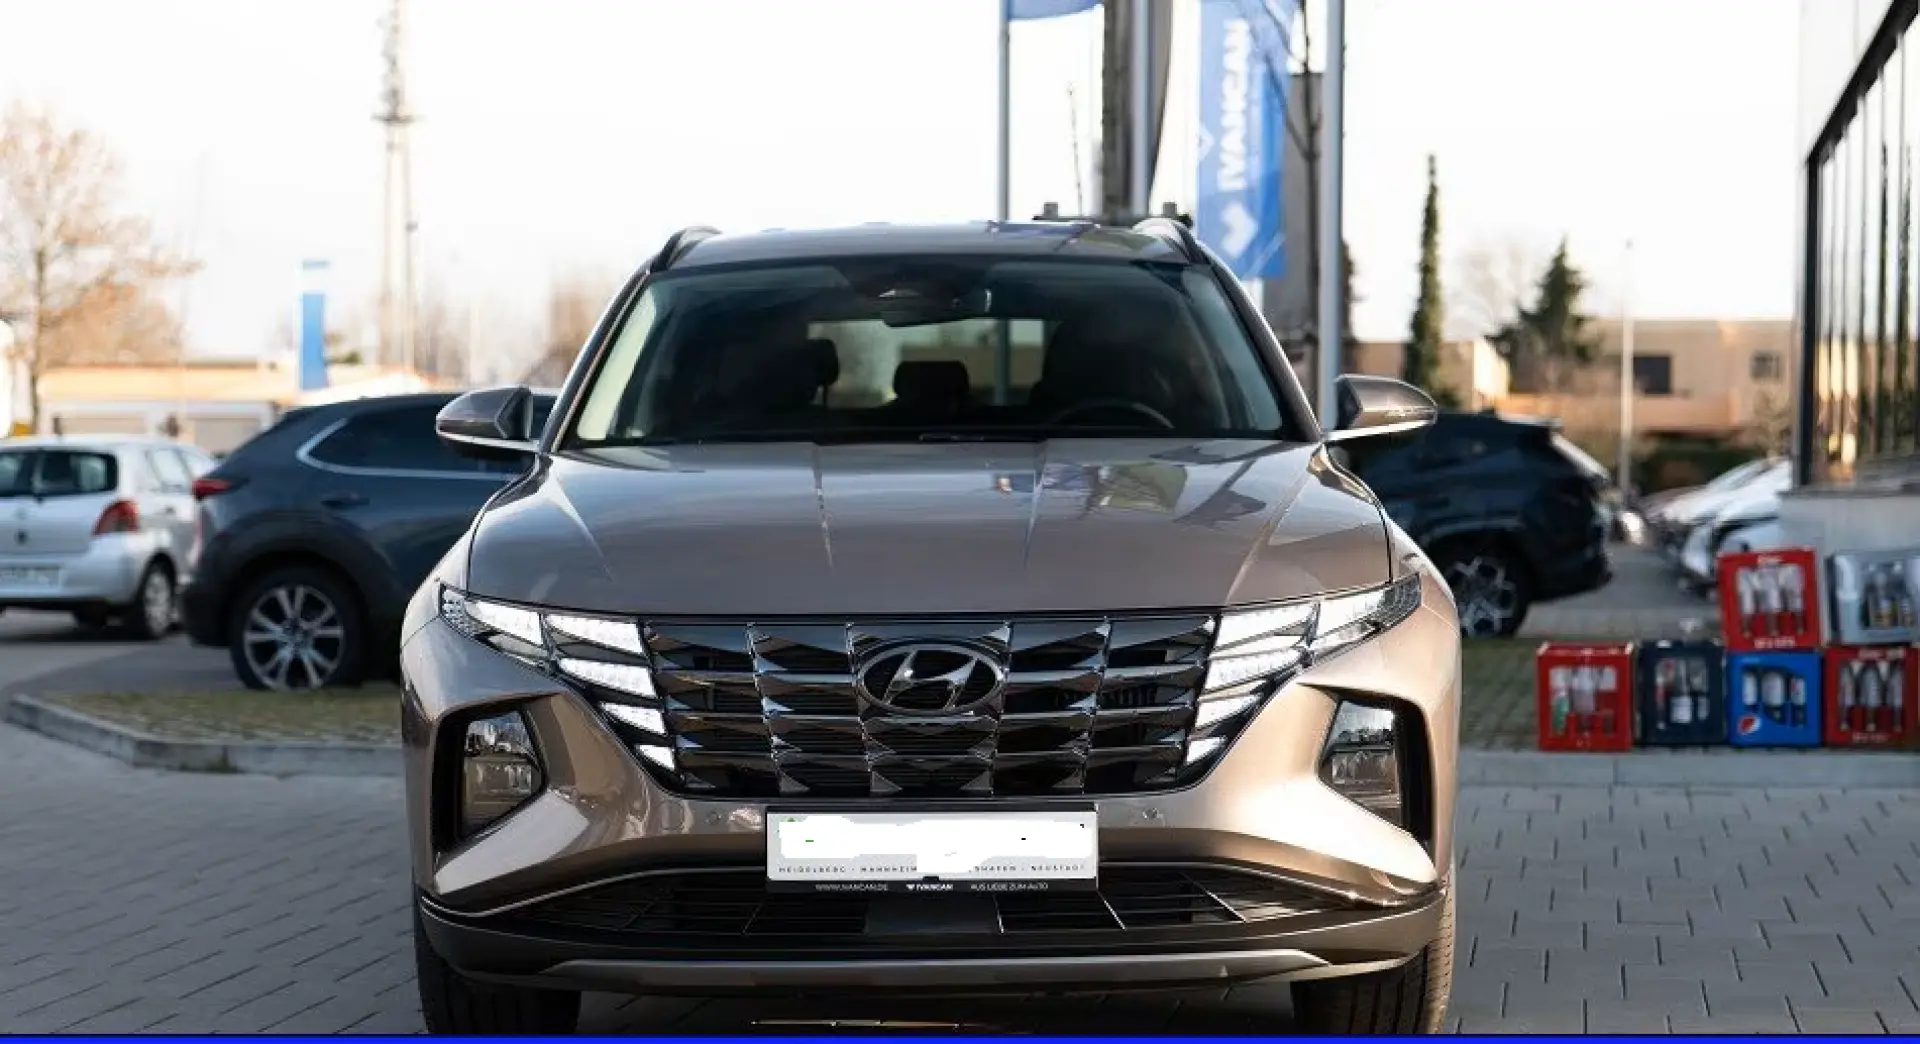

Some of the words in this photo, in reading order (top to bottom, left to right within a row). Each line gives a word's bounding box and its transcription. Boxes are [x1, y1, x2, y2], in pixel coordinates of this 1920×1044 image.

[1217, 18, 1249, 191] IVANCAN
[916, 883, 954, 891] IVANCAN
[970, 883, 986, 891] AUS
[987, 883, 1008, 891] LIEBE
[1009, 883, 1026, 891] ZUM
[1027, 883, 1049, 891] AUTO
